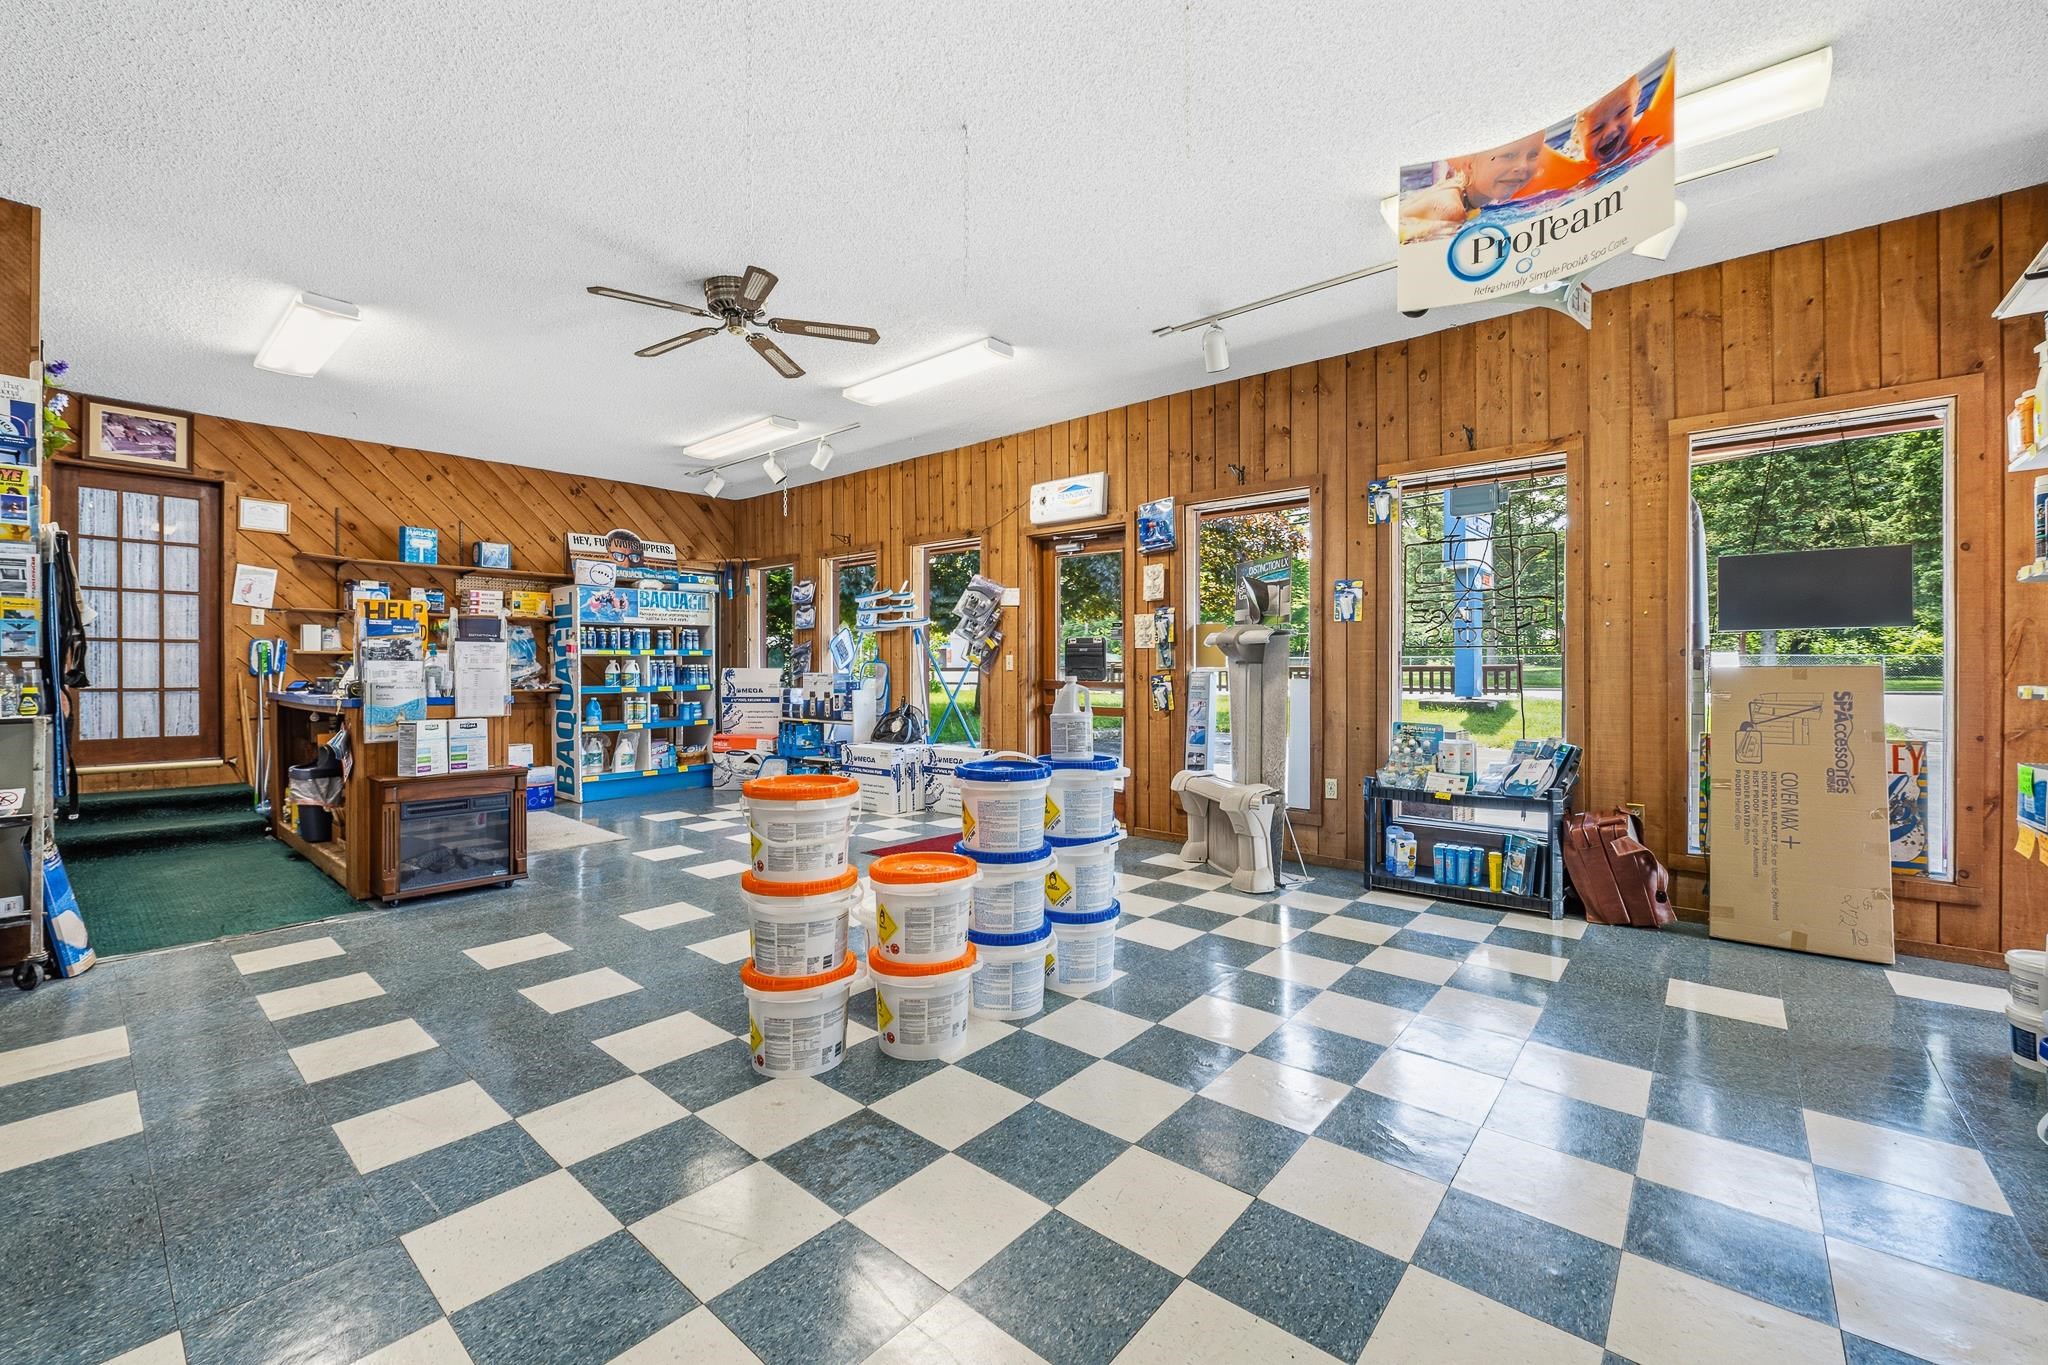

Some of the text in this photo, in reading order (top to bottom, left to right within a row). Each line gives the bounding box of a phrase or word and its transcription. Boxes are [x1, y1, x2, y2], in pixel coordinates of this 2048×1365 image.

[1473, 276, 1528, 296] Refreshingly
[1529, 266, 1560, 283] Simple
[1591, 248, 1606, 261] Spa
[1608, 236, 1629, 254] Care
[573, 535, 592, 547] HEY,
[594, 537, 611, 547] FUN
[614, 539, 674, 555] WORSHIPPERS.
[1280, 557, 1289, 567] LX
[364, 601, 423, 620] HELP
[640, 591, 709, 610] BAQUACIL
[553, 592, 576, 795] BAQUACIL
[1833, 691, 1854, 794] SPAccessories
[1887, 744, 1925, 776] EY
[1781, 772, 1799, 807] COVER
[1781, 807, 1799, 831] MAX
